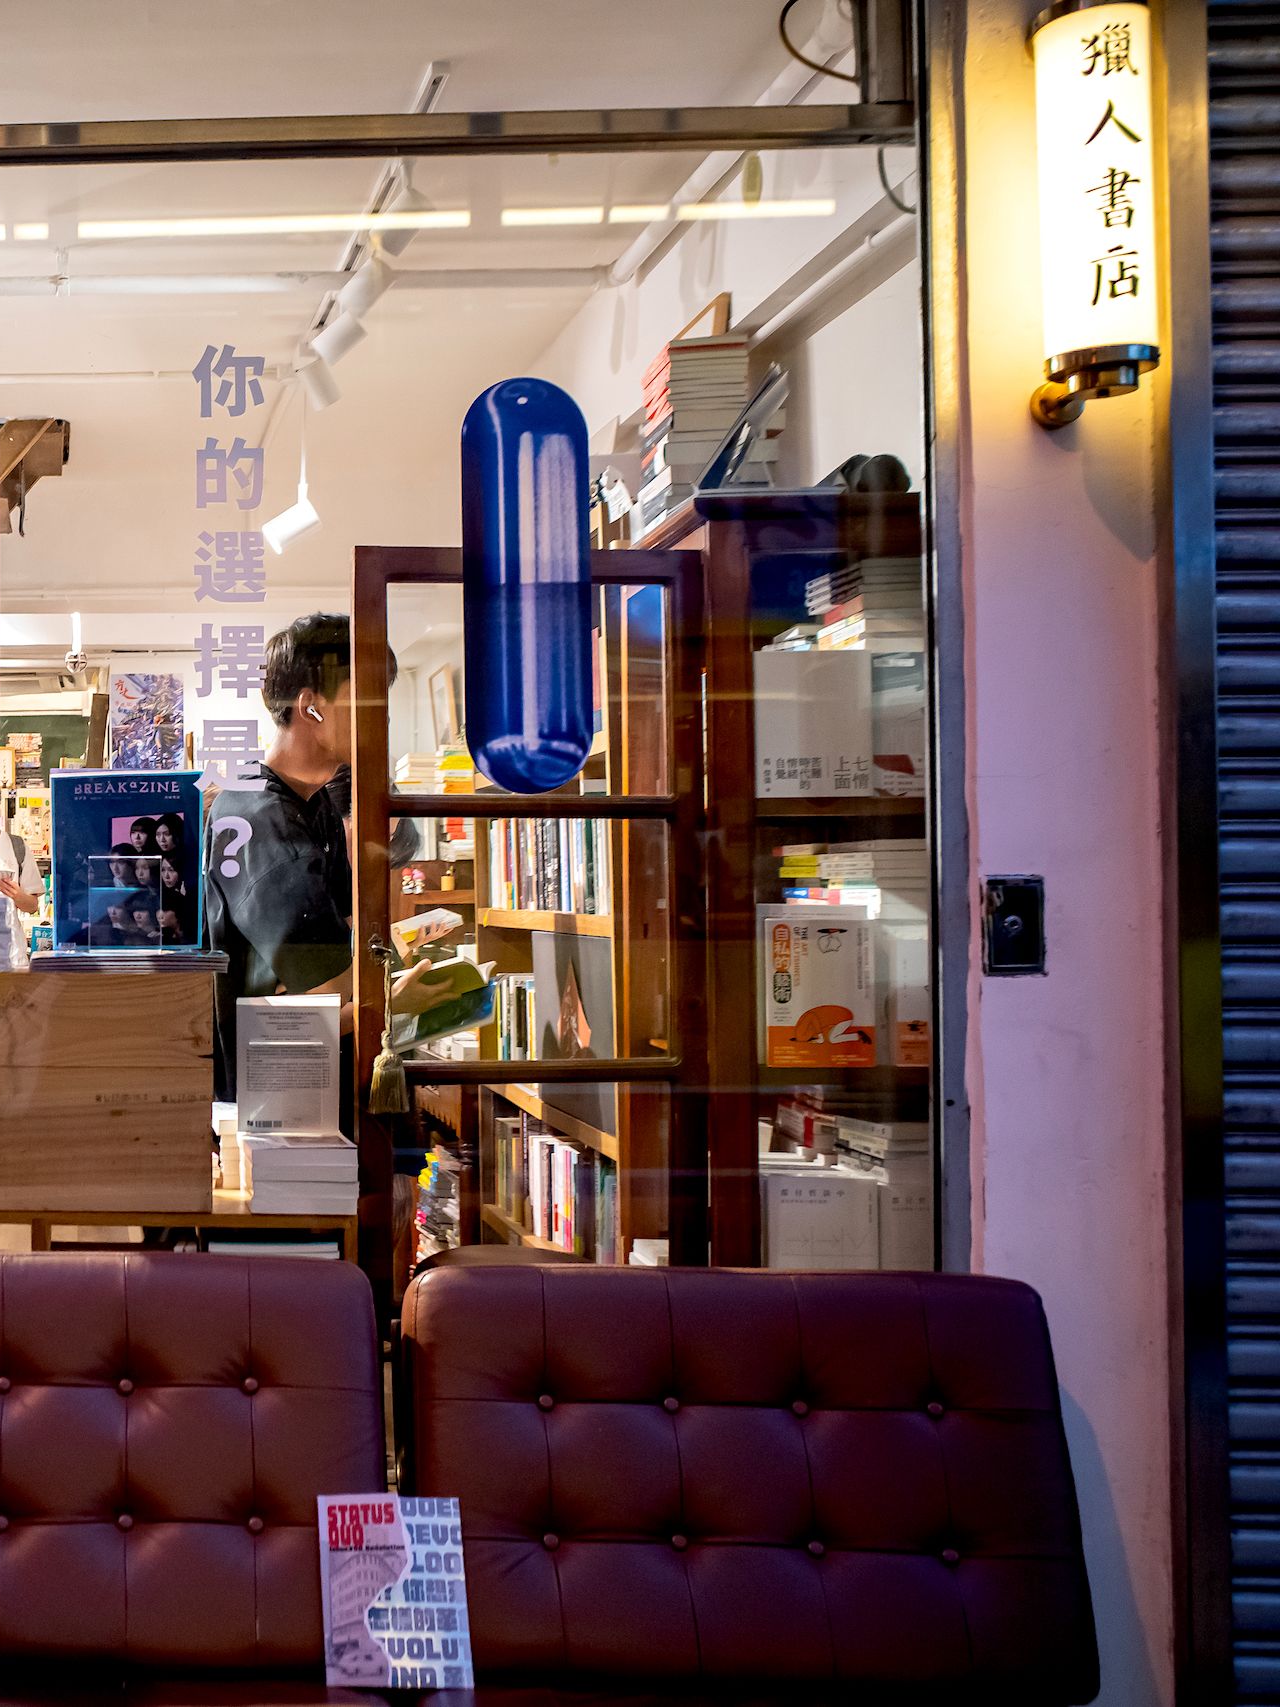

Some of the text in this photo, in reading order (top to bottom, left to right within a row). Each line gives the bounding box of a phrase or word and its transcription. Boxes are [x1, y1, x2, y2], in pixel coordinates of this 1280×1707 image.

[1080, 21, 1143, 306] 獵人書店
[833, 755, 851, 790] 上面
[851, 755, 870, 790] 七情
[327, 1503, 395, 1525] STATUS
[328, 1524, 364, 1549] QUO
[375, 1637, 459, 1660] VOLU
